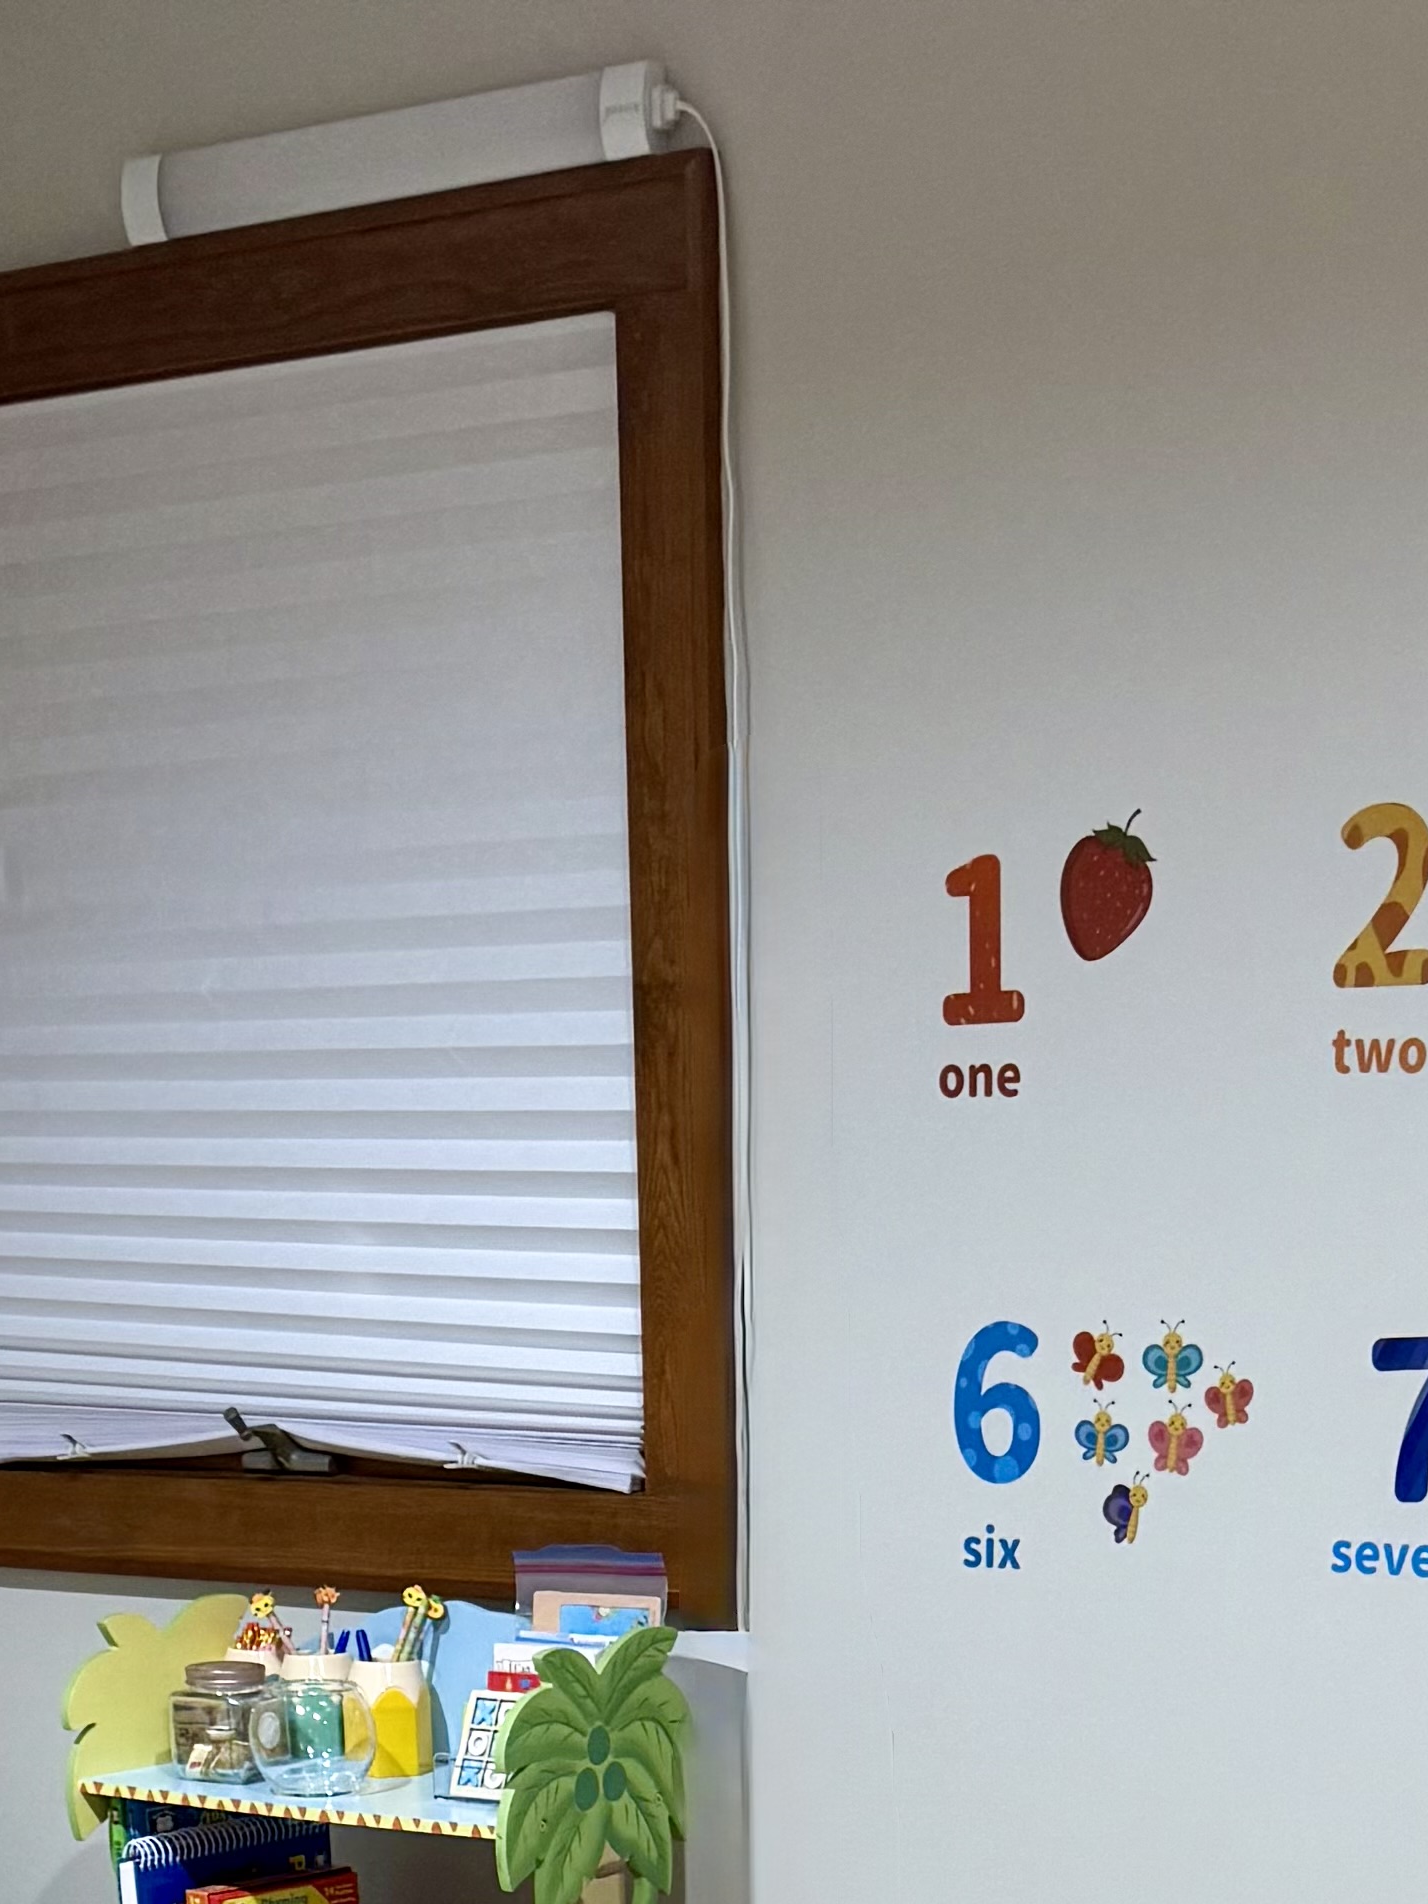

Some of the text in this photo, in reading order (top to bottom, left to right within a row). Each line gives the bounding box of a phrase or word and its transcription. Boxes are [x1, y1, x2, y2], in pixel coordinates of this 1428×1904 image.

[943, 854, 1025, 1026] 1
[1332, 1029, 1427, 1074] two
[939, 1063, 1021, 1098] one
[954, 1321, 1040, 1484] 6
[963, 1524, 1021, 1570] six
